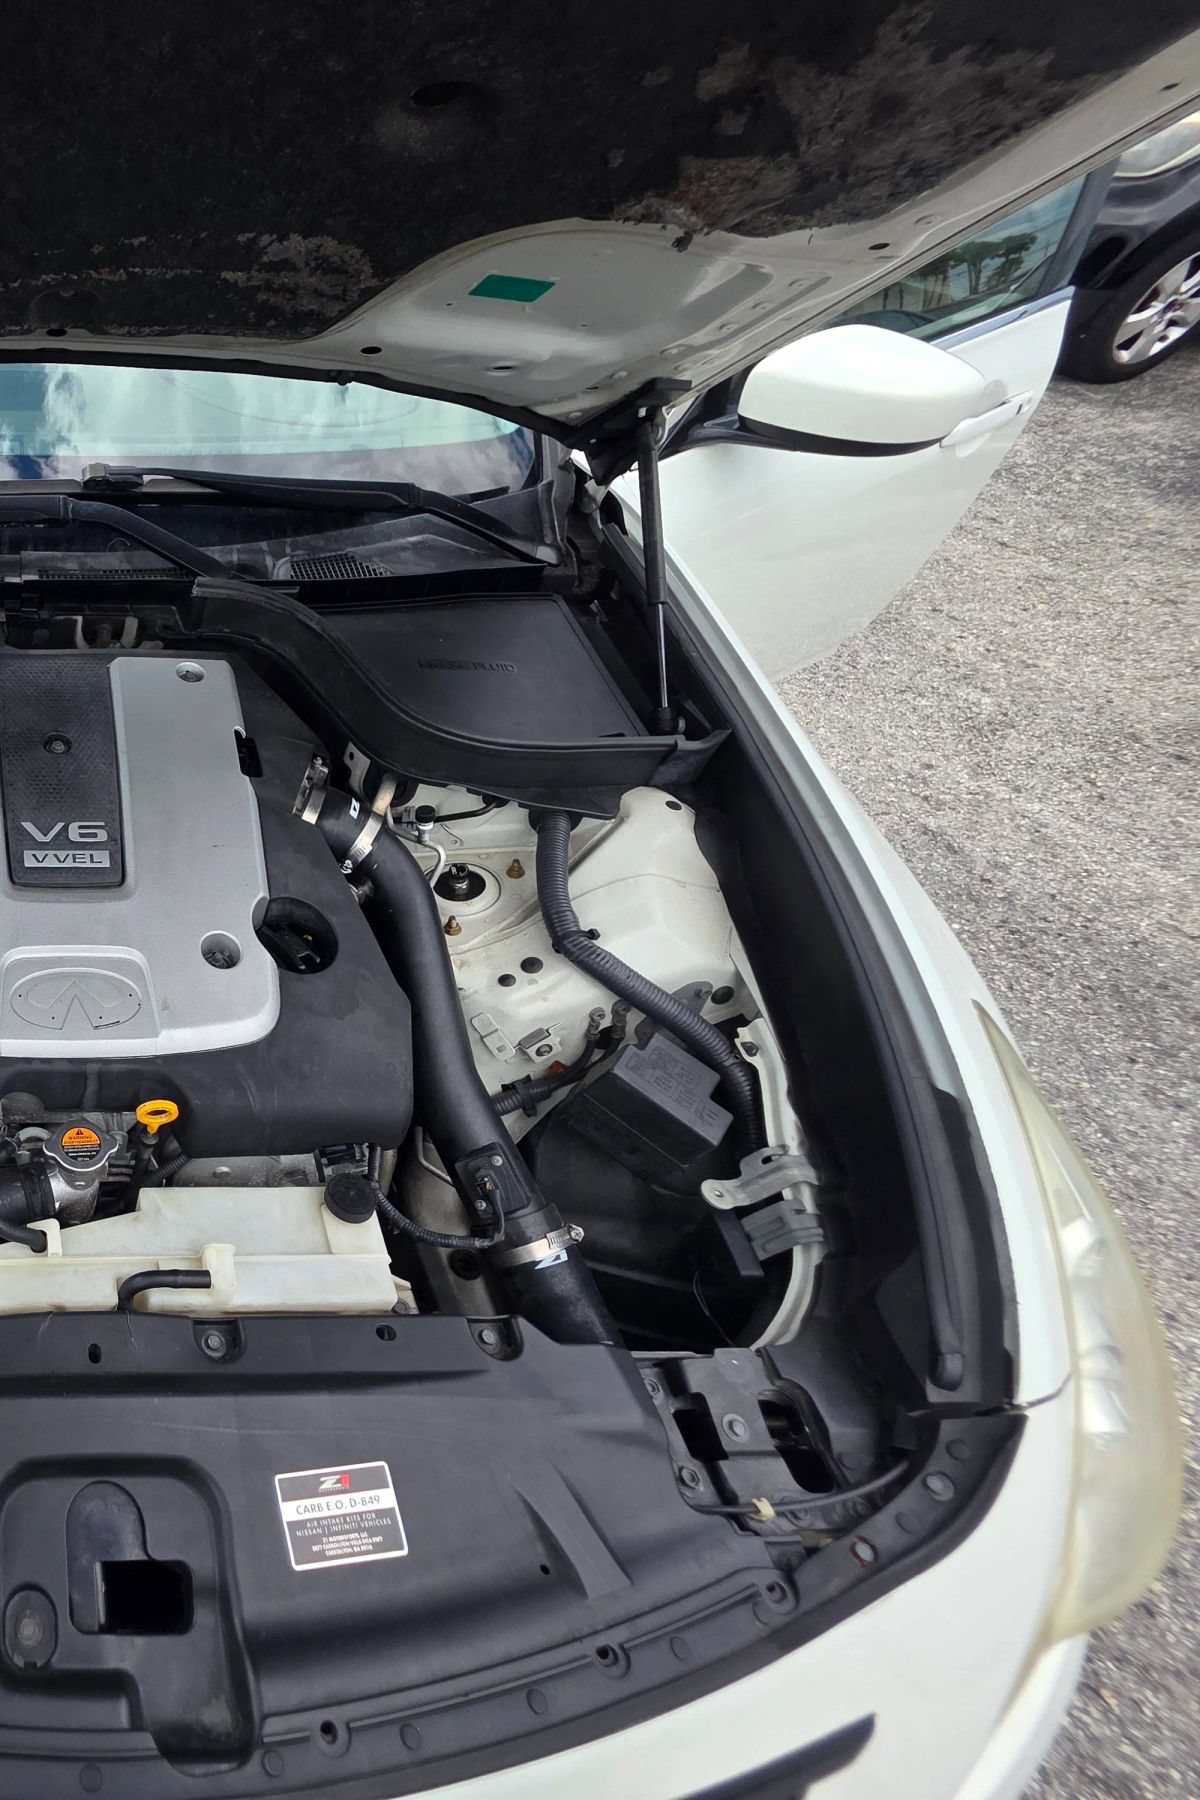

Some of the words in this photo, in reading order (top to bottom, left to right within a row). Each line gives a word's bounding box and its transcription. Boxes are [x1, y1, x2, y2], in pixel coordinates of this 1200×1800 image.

[472, 662, 516, 672] FLUID
[20, 822, 107, 842] V6
[31, 853, 103, 864] VVEL
[296, 1502, 324, 1515] CARB
[350, 1495, 380, 1508] D-849
[296, 1527, 322, 1537] NISSAN
[330, 1524, 359, 1533] INFINITI
[360, 1517, 392, 1528] VEHICLES
[306, 1520, 318, 1528] AIR
[320, 1517, 344, 1526] INTAKE
[346, 1515, 361, 1523] KITS
[362, 1513, 376, 1521] FOR
